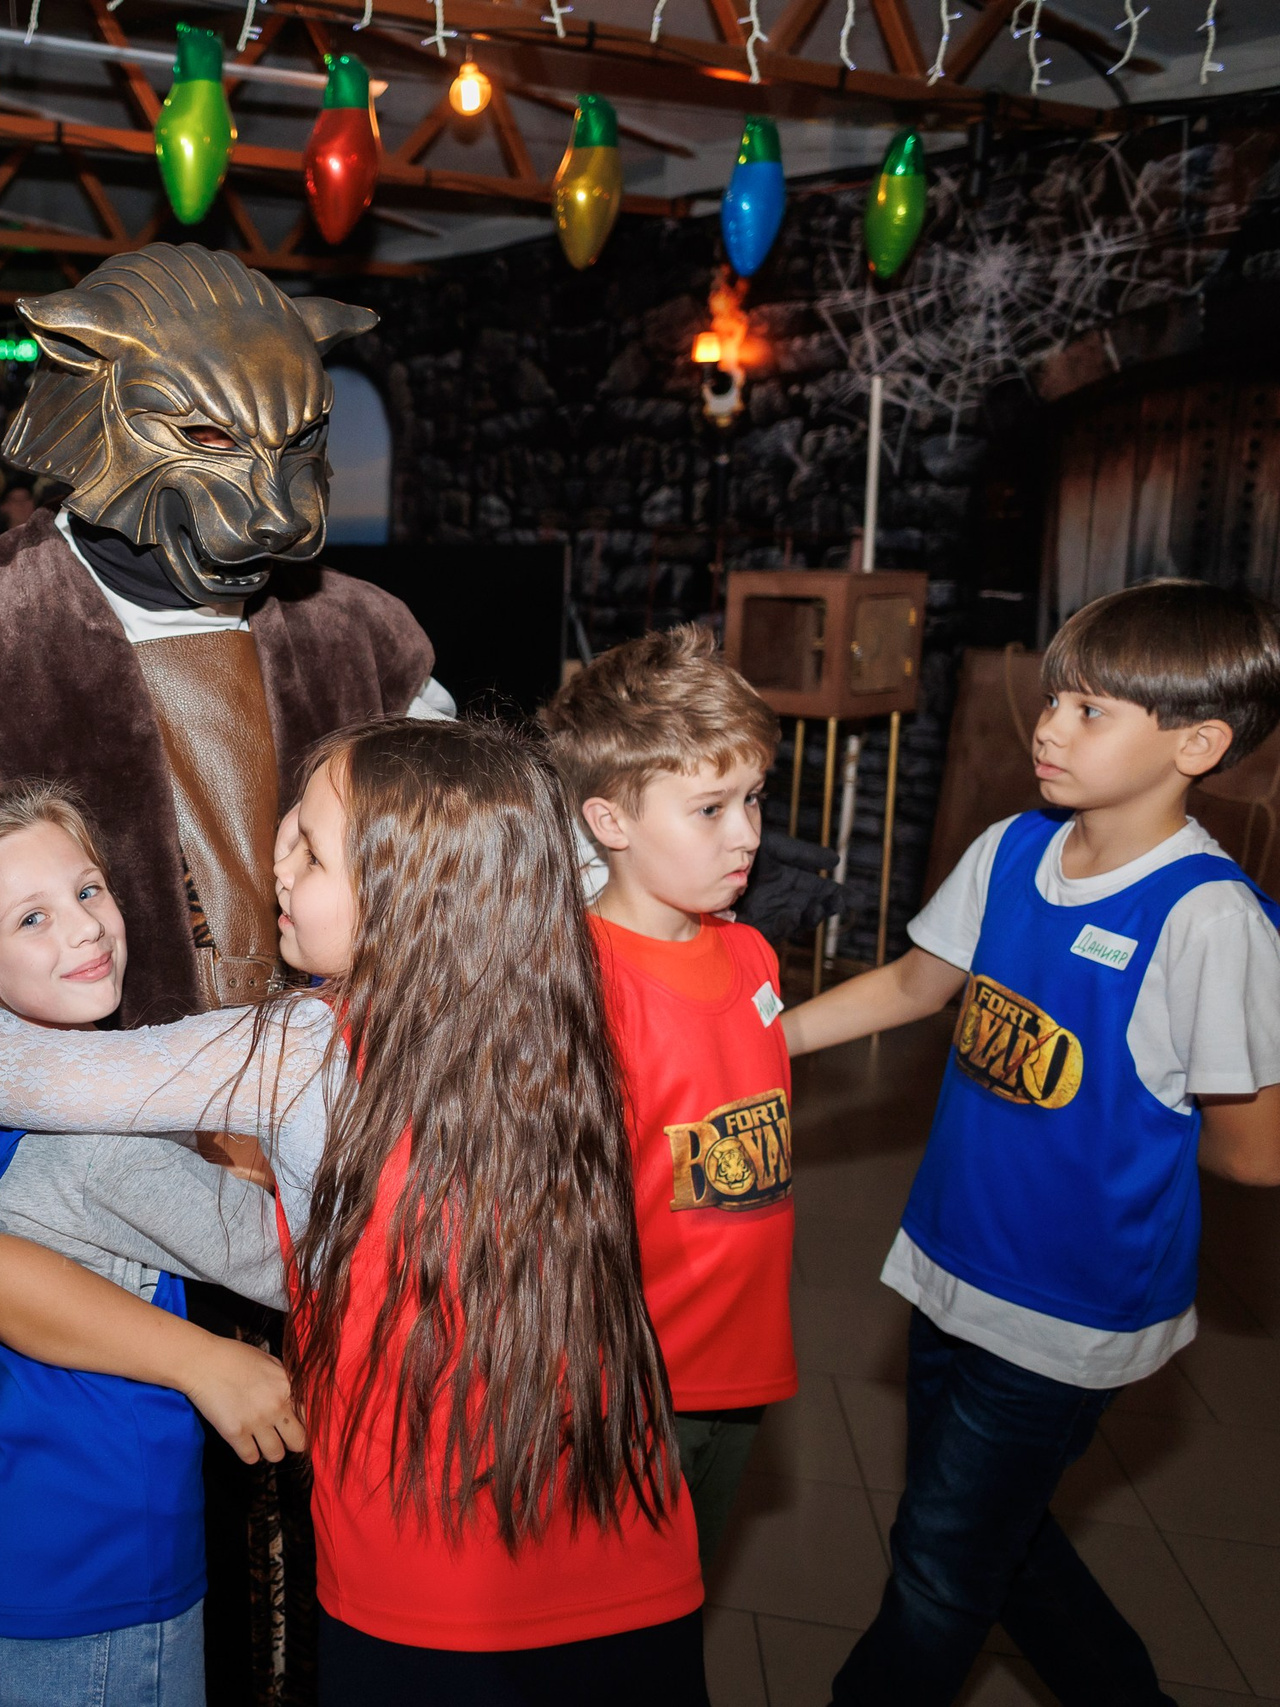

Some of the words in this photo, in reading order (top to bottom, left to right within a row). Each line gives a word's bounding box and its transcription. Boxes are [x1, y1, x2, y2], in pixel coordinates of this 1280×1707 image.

[978, 985, 1033, 1029] FORT
[956, 990, 1084, 1109] OYARD
[725, 1101, 779, 1135] FORT
